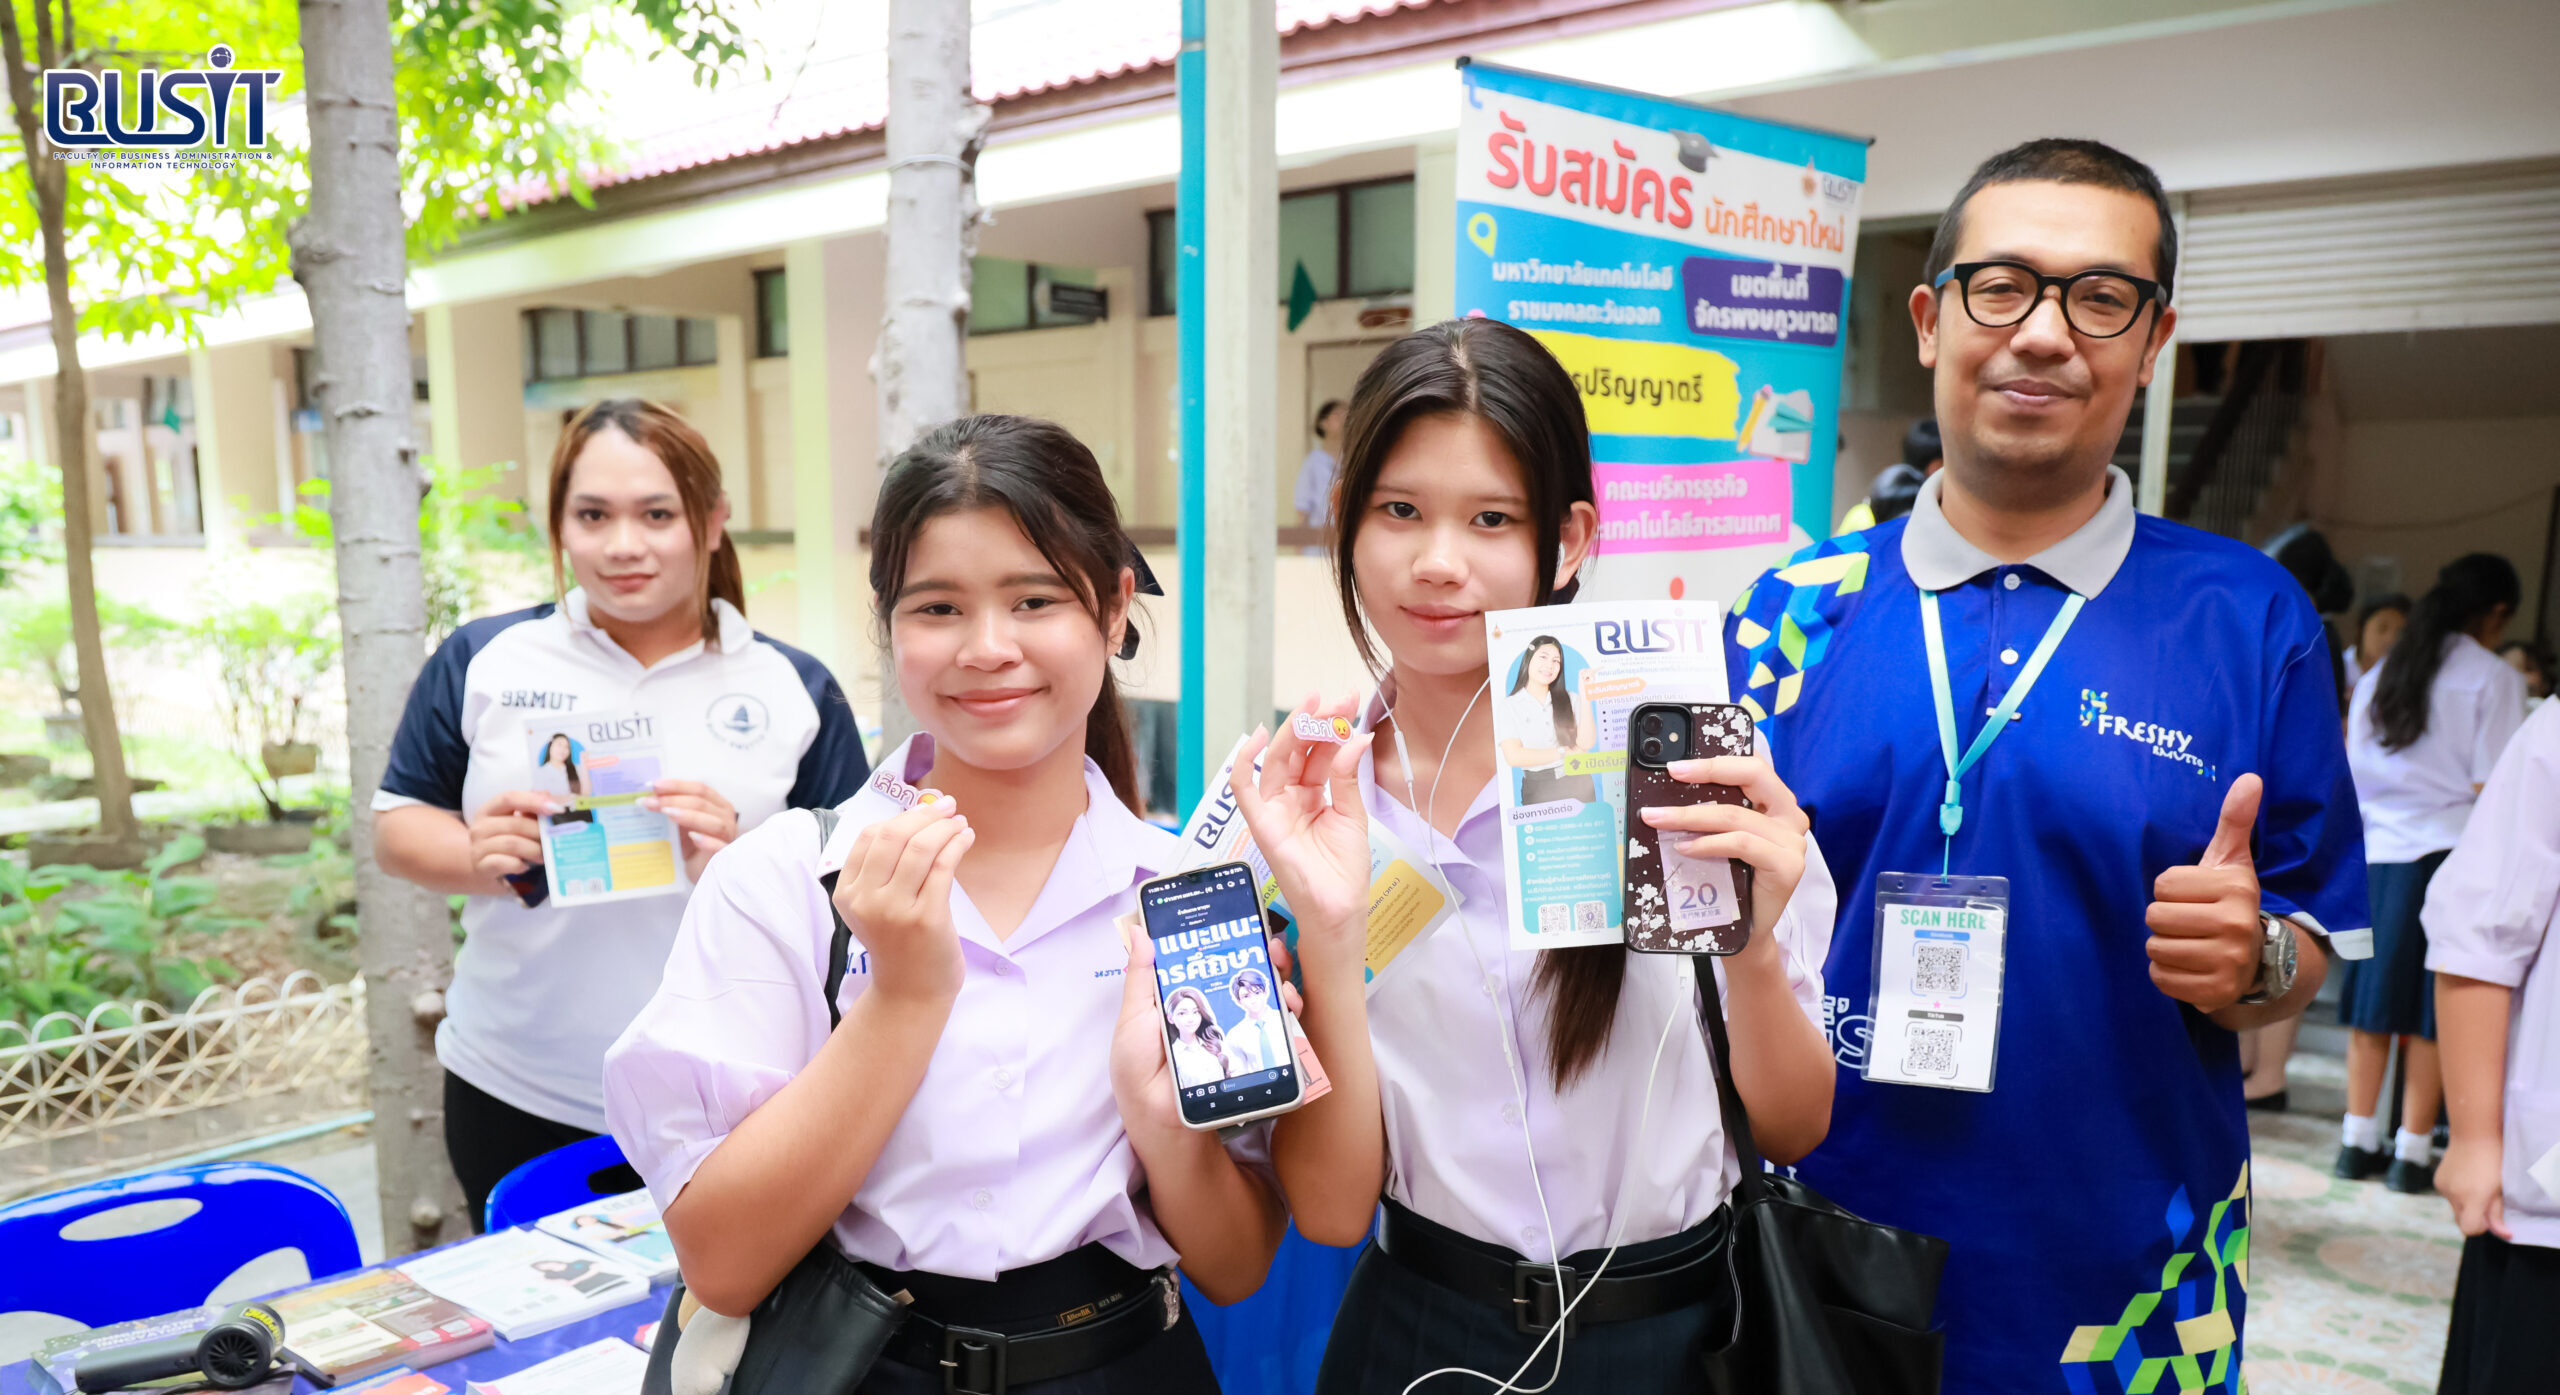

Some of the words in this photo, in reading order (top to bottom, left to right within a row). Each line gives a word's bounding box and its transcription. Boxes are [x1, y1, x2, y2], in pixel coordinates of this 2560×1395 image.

[1486, 110, 1695, 230] รับสมัคร
[1704, 198, 1846, 253] นักศึกษาใหม่
[1492, 258, 1673, 291] มหาวิทยาลัยเทคโนโลยี
[1731, 264, 1810, 300] เขตพื้นที่
[2098, 713, 2193, 753] FRESHY
[1680, 883, 1718, 910] 20
[1900, 909, 1941, 926] SCAN
